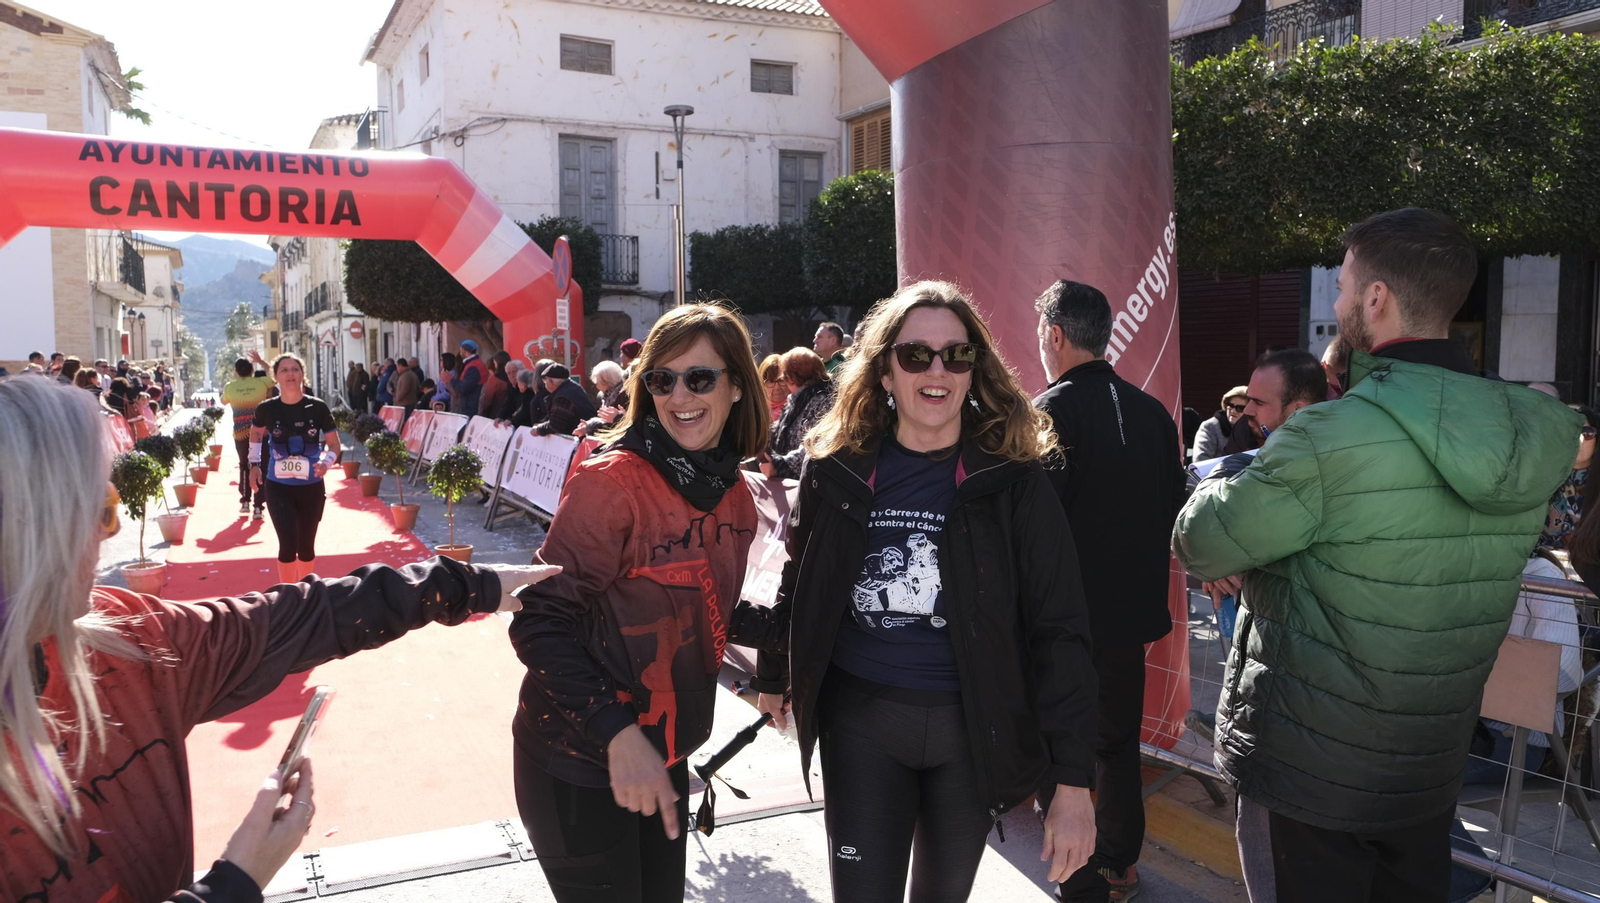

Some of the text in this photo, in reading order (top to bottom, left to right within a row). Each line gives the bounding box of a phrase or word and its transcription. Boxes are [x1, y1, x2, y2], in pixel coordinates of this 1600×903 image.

[79, 140, 369, 177] AYUNTAMIENTO
[89, 176, 361, 226] CANTORIA
[281, 461, 302, 471] 306
[515, 457, 562, 492] CANTORIA
[878, 510, 884, 518] y
[884, 508, 920, 518] Carrera
[921, 511, 935, 519] de
[917, 522, 943, 532] Cánc
[697, 566, 713, 593] LA
